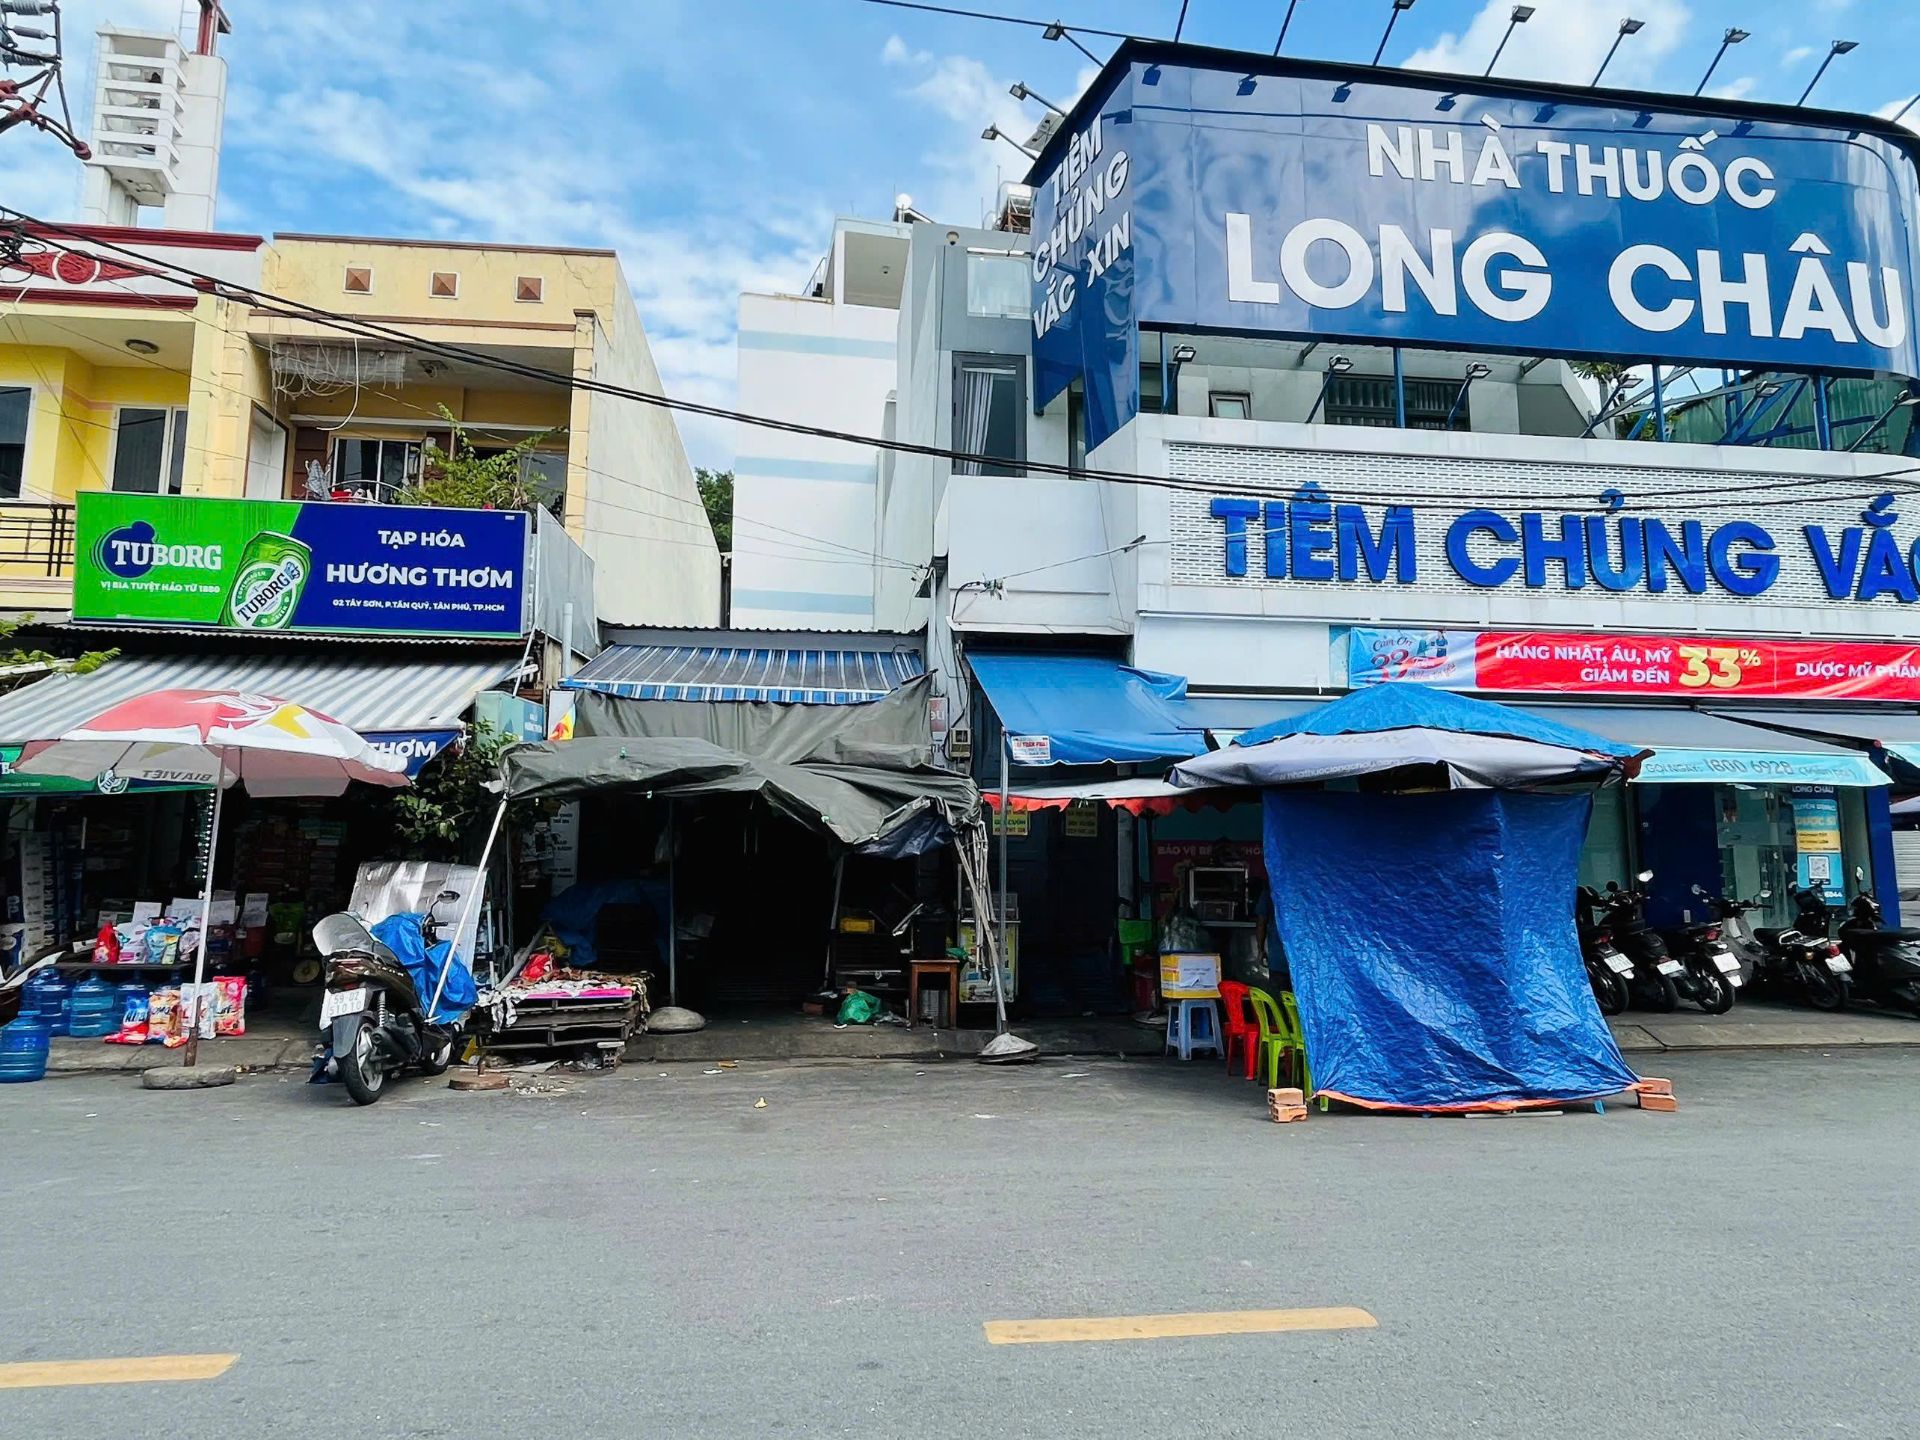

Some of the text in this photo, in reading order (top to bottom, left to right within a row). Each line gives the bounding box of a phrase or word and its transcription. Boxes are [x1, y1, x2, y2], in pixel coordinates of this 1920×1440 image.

[1050, 112, 1103, 206] TIÊM
[1368, 113, 1778, 210] NHÀ THUỐC
[1032, 150, 1130, 283] CHỦNG
[1032, 211, 1132, 340] VẮC XIN
[1225, 212, 1907, 350] LONG CHÂU
[111, 539, 222, 571] TUBORG
[377, 528, 465, 550] TẠP HÓA
[1210, 481, 1920, 603] TIÊM CHỦNG VẮ
[100, 580, 111, 591] VỊ
[326, 561, 513, 588] HƯƠNG THƠM
[237, 572, 291, 622] TUBORG
[345, 598, 362, 607] TÂY
[1496, 641, 1672, 666] HÀNG NHẬT, ÂU, MỸ
[1678, 645, 1762, 688] 33%
[1580, 663, 1670, 685] GIẢM ĐẾN
[1795, 661, 1846, 680] DƯỢC
[1848, 660, 1873, 678] MỸ
[1707, 759, 1747, 773] 1800
[1750, 759, 1794, 775] 6928
